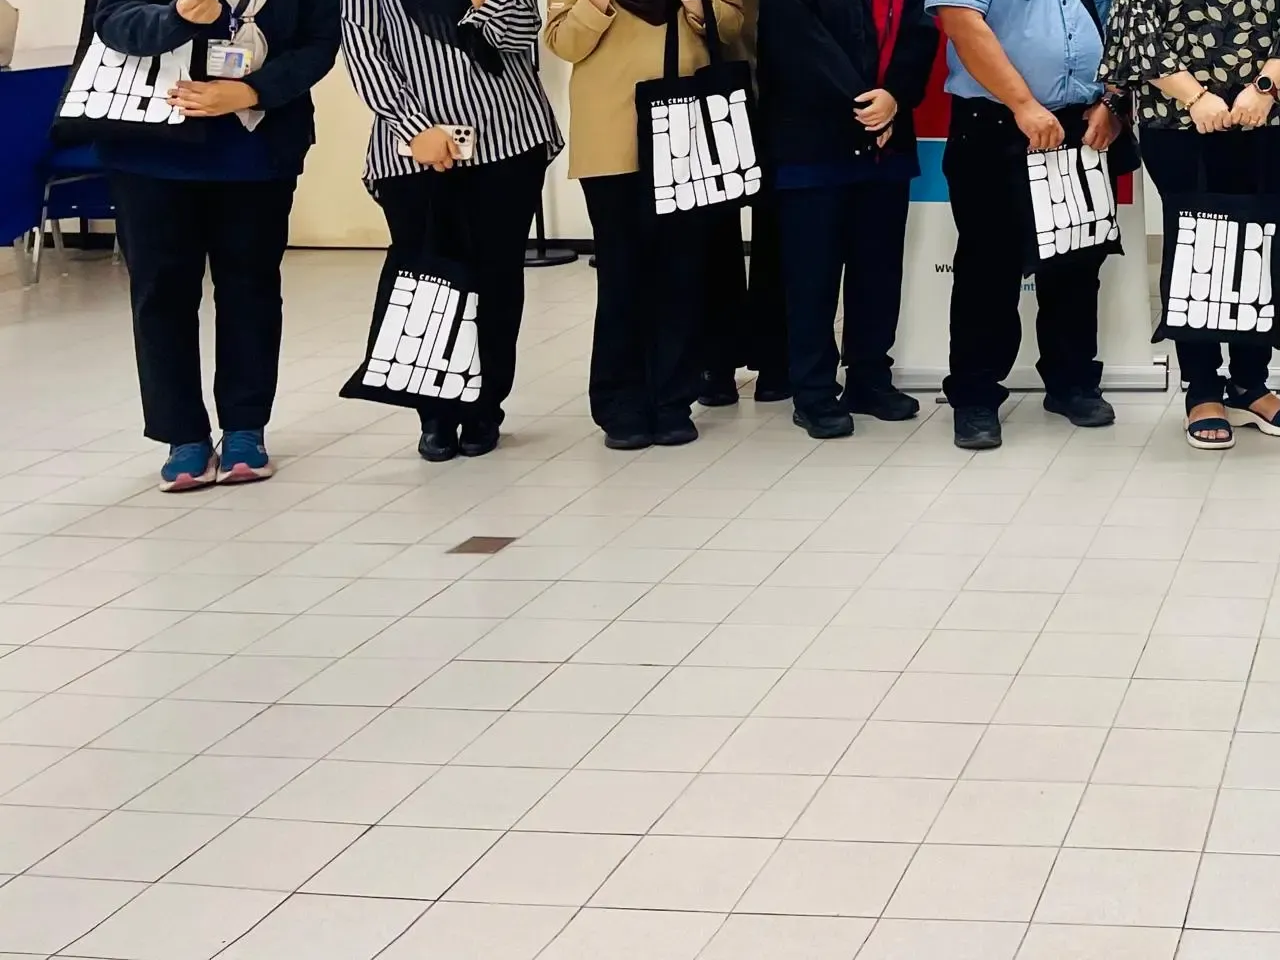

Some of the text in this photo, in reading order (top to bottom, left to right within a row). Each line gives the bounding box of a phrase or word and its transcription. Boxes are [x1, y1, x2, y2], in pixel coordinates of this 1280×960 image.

[654, 166, 763, 215] BUILDS
[1197, 212, 1229, 220] CEMENT
[398, 270, 414, 278] YTL
[1166, 297, 1275, 333] BUILDS
[361, 357, 483, 403] BUILDS
